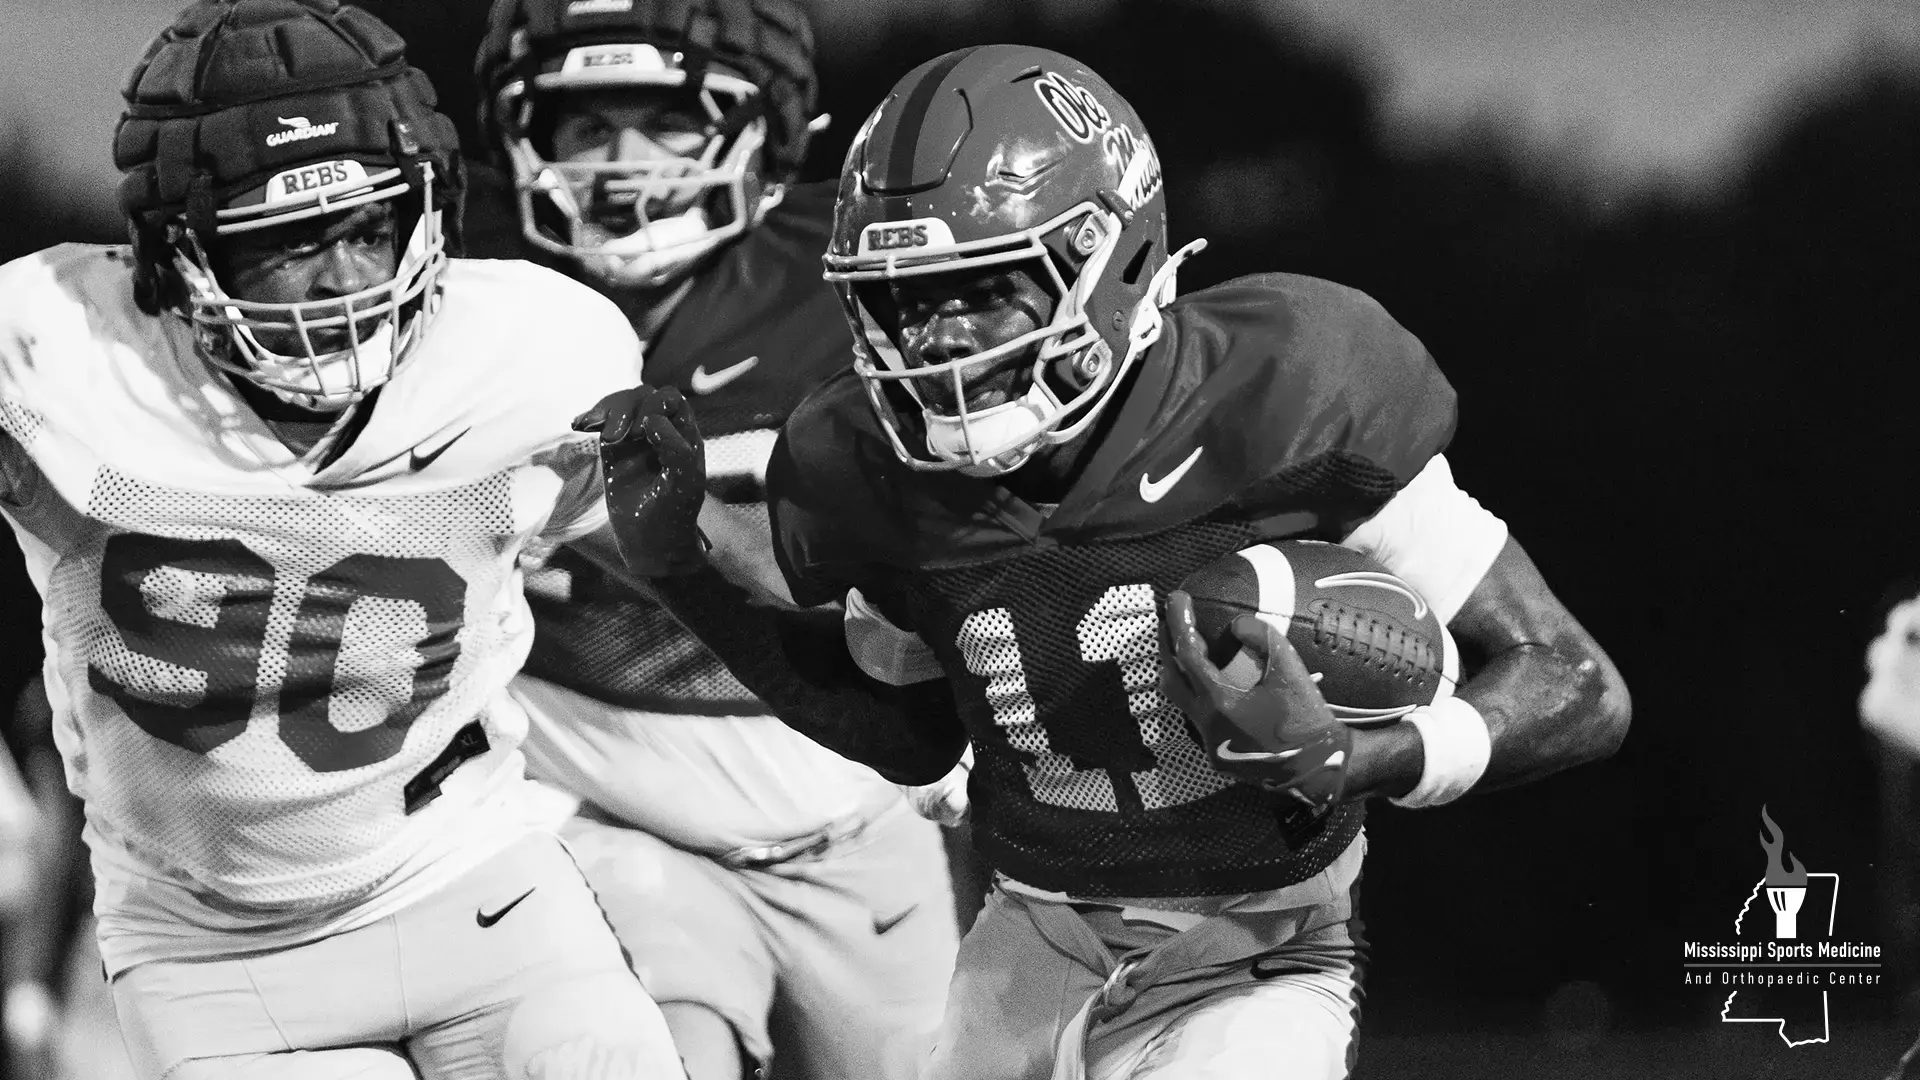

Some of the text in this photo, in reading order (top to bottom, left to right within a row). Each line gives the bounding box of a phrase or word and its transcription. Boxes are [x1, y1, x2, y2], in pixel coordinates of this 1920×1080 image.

[1034, 72, 1111, 144] Ole
[266, 122, 339, 147] GUARDIAN
[282, 161, 347, 194] REBS
[868, 225, 928, 251] REBS
[88, 532, 467, 772] 90
[955, 584, 1234, 812] 11
